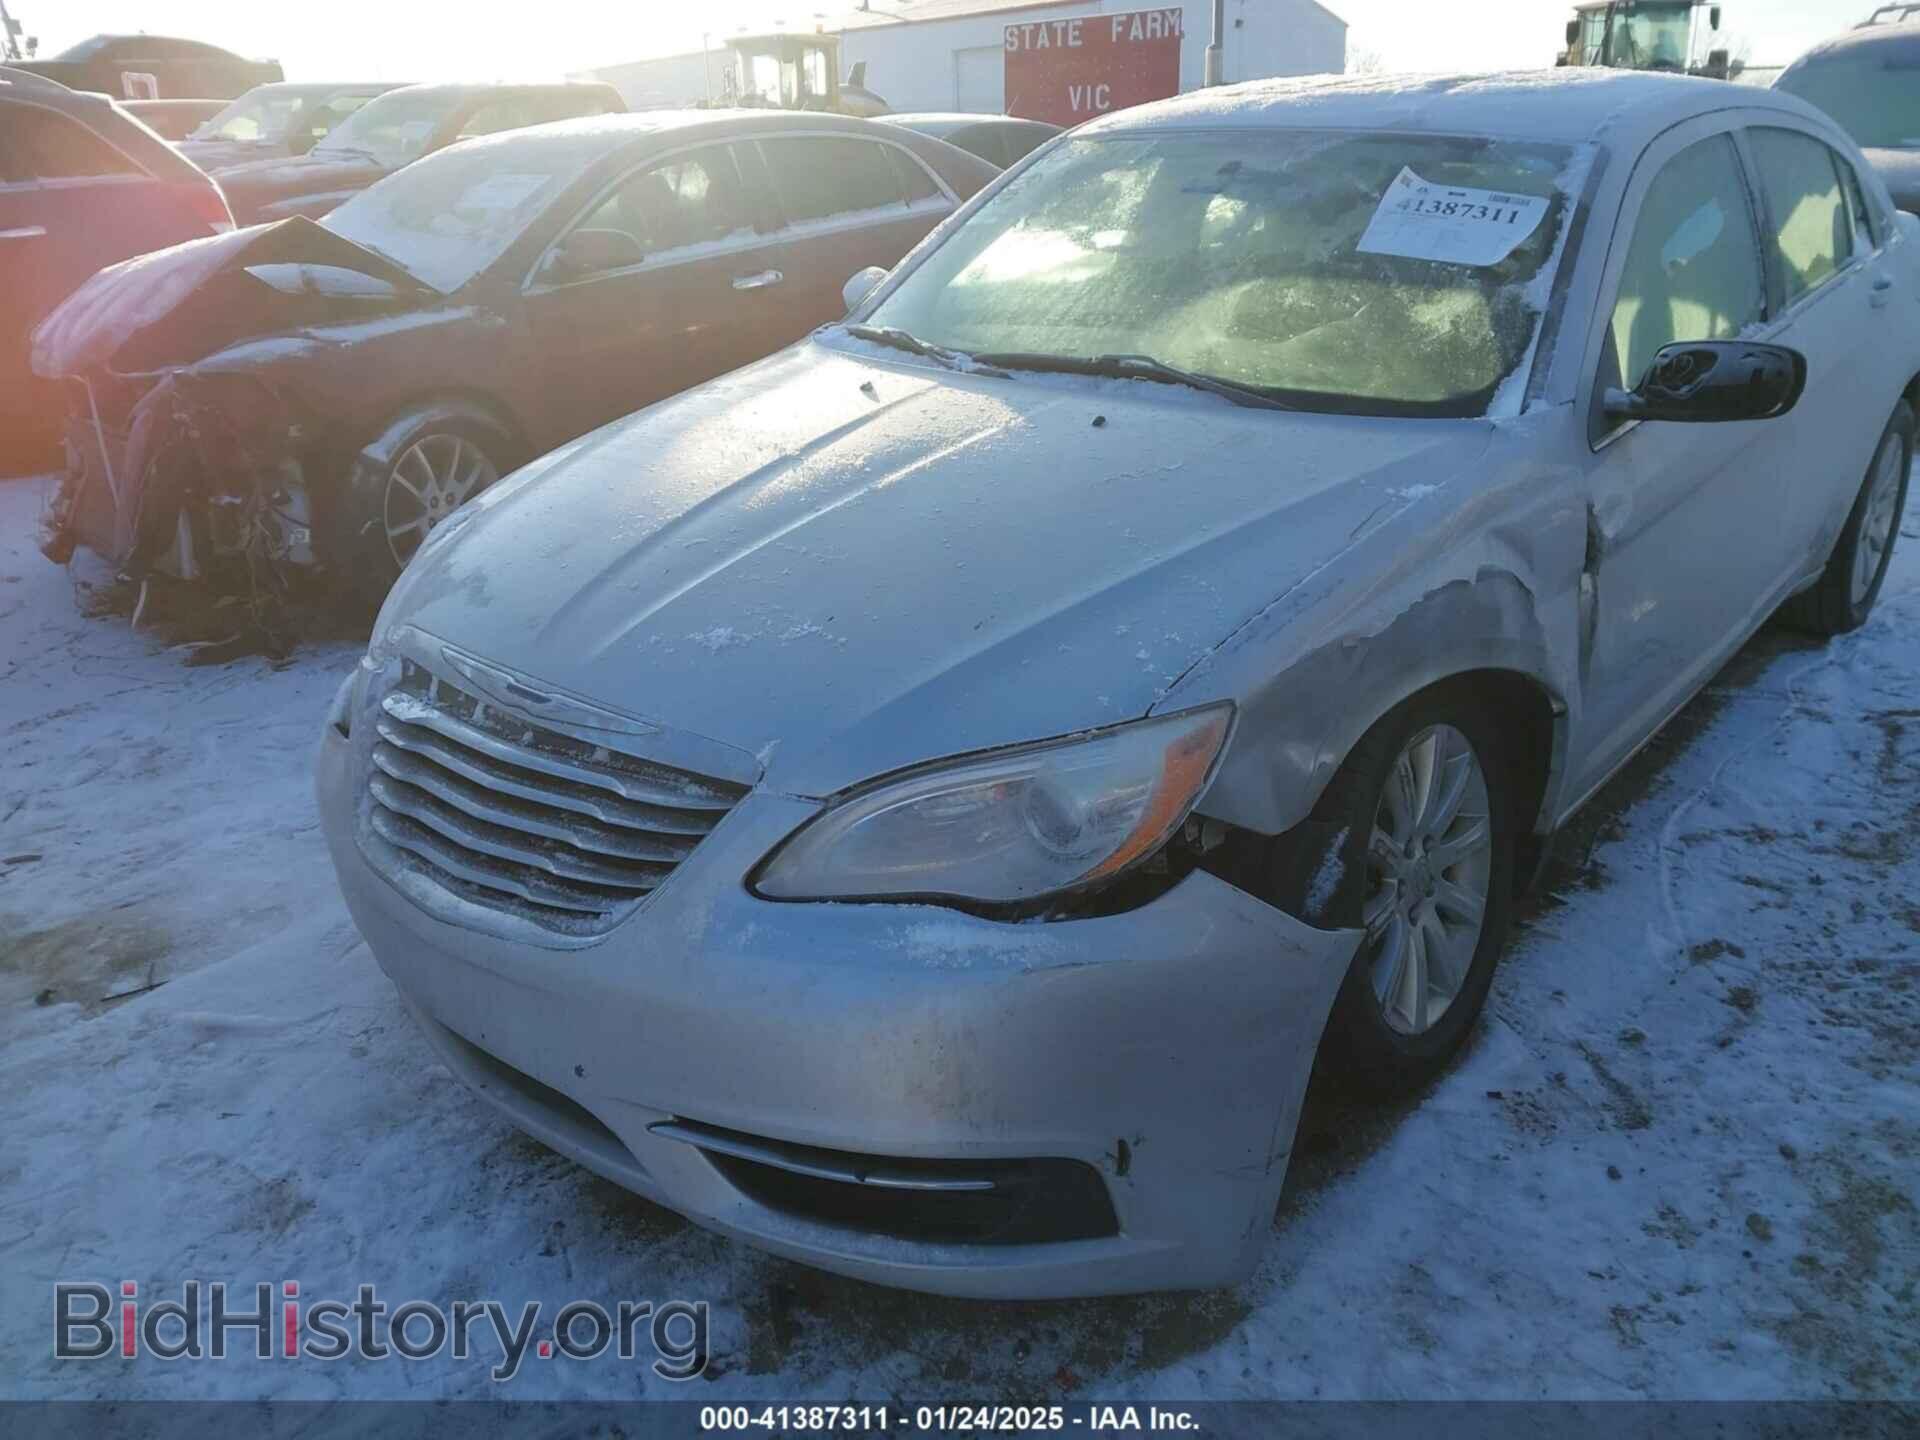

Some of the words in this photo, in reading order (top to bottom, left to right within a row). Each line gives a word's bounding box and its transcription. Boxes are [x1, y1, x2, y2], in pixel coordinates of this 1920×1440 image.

[1005, 19, 1083, 50] STATE
[1111, 9, 1180, 42] FARM
[1069, 84, 1110, 111] VIC
[1395, 198, 1519, 224] 41387311
